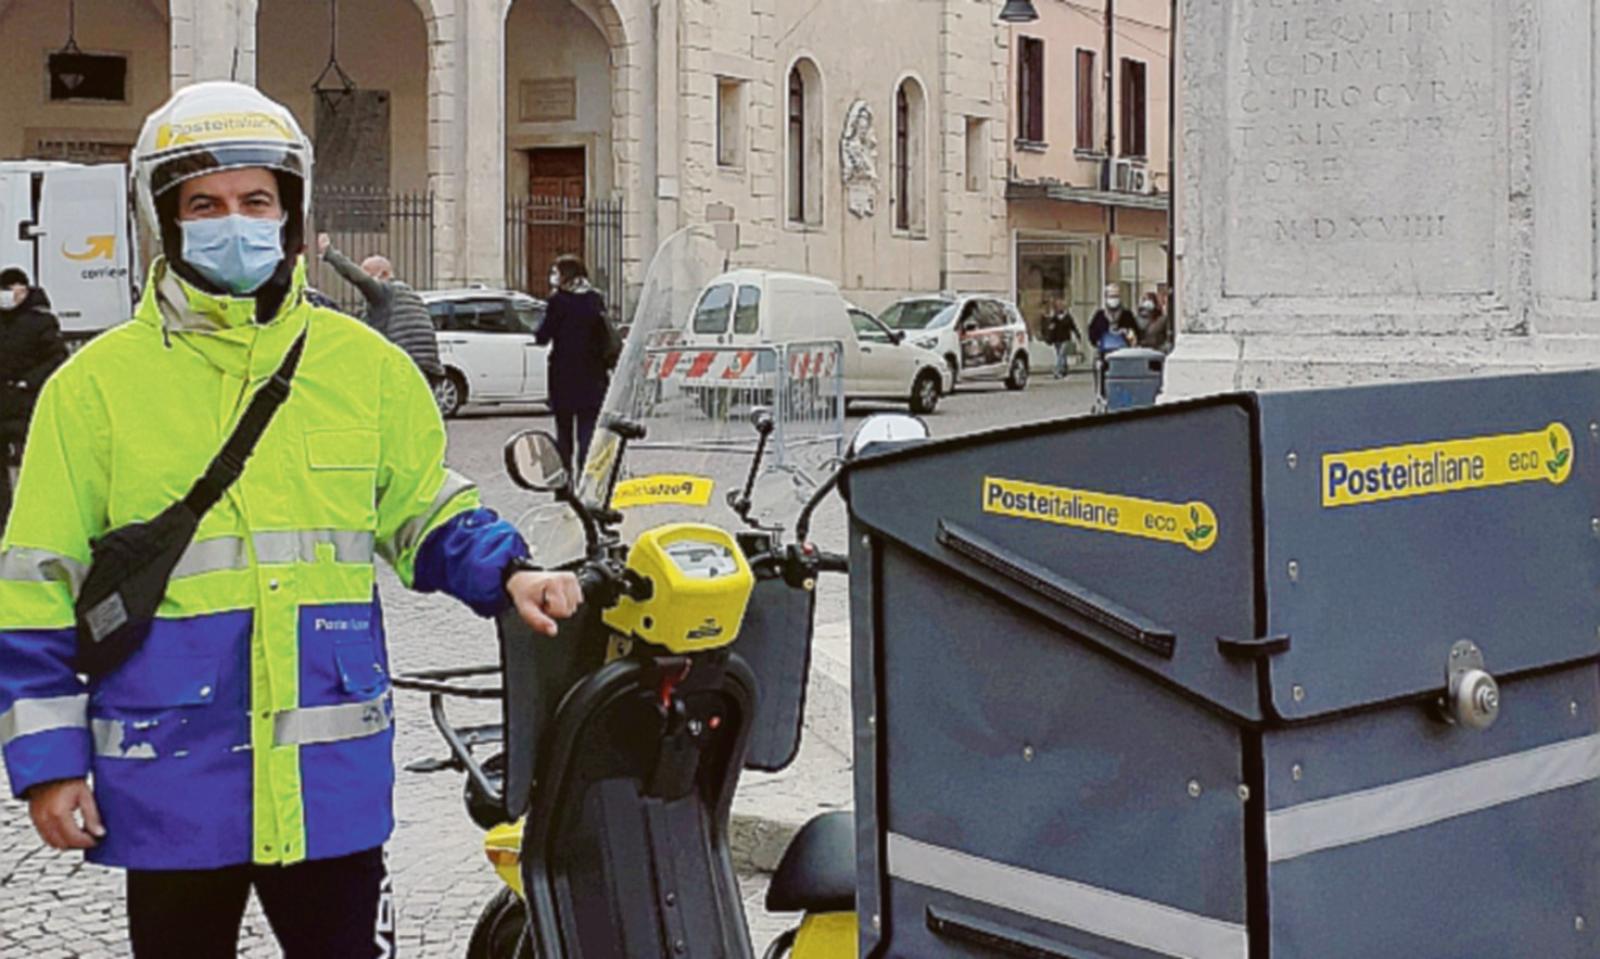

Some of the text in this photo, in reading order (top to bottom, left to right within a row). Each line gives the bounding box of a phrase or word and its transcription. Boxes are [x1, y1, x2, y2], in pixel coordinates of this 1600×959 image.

[1328, 450, 1541, 499] Posteitaliane eco
[987, 482, 1178, 533] Posteitaliane eco
